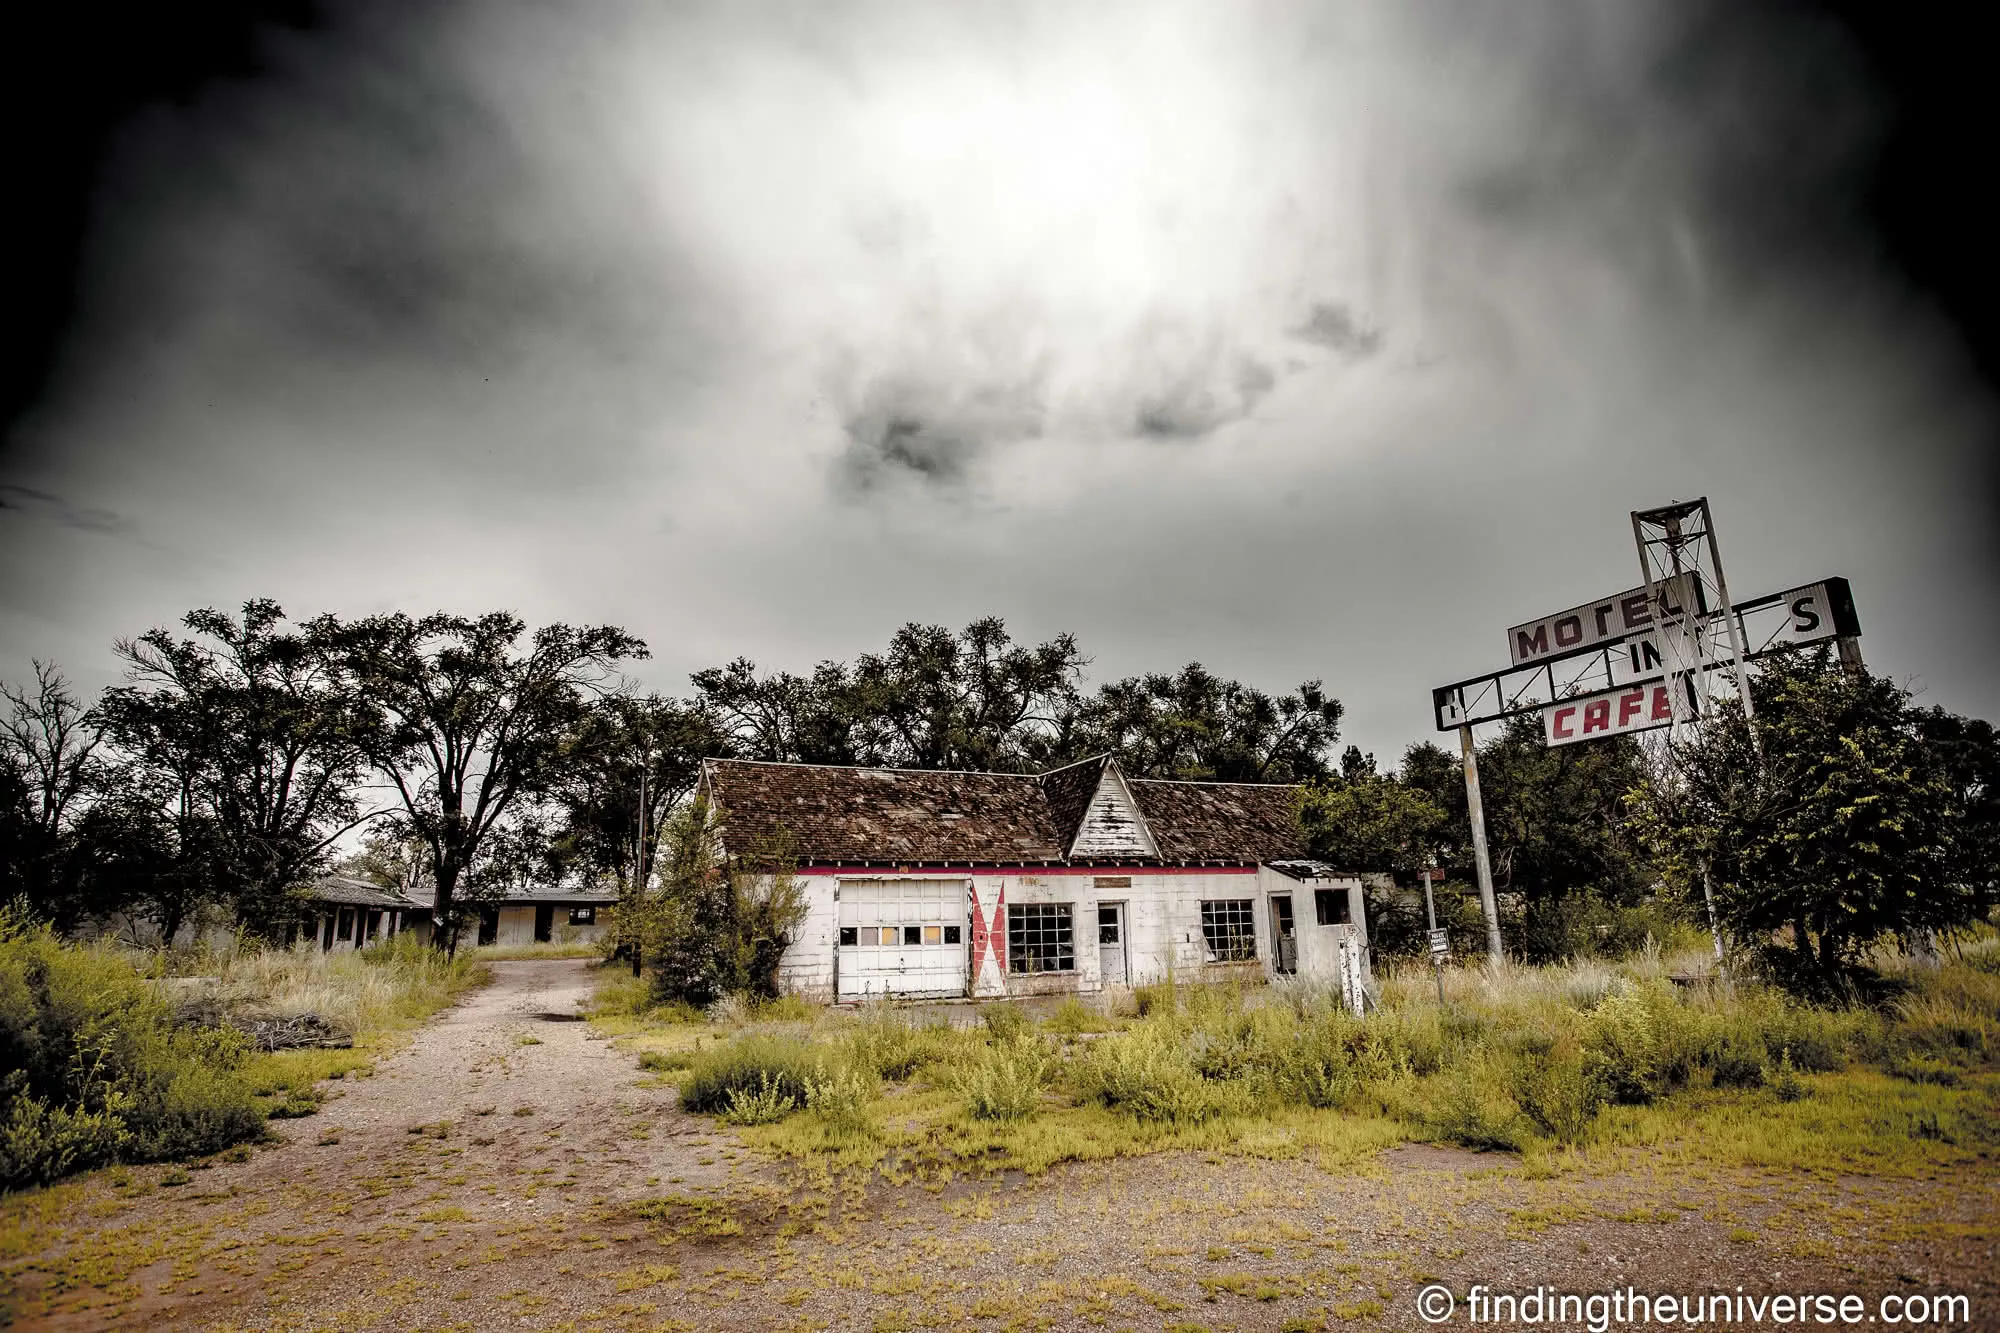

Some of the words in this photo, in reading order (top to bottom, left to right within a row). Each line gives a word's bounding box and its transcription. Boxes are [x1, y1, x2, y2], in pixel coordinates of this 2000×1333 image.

[1517, 587, 1685, 659] MOTEL
[1791, 596, 1820, 632] S
[1552, 687, 1673, 740] CAFE
